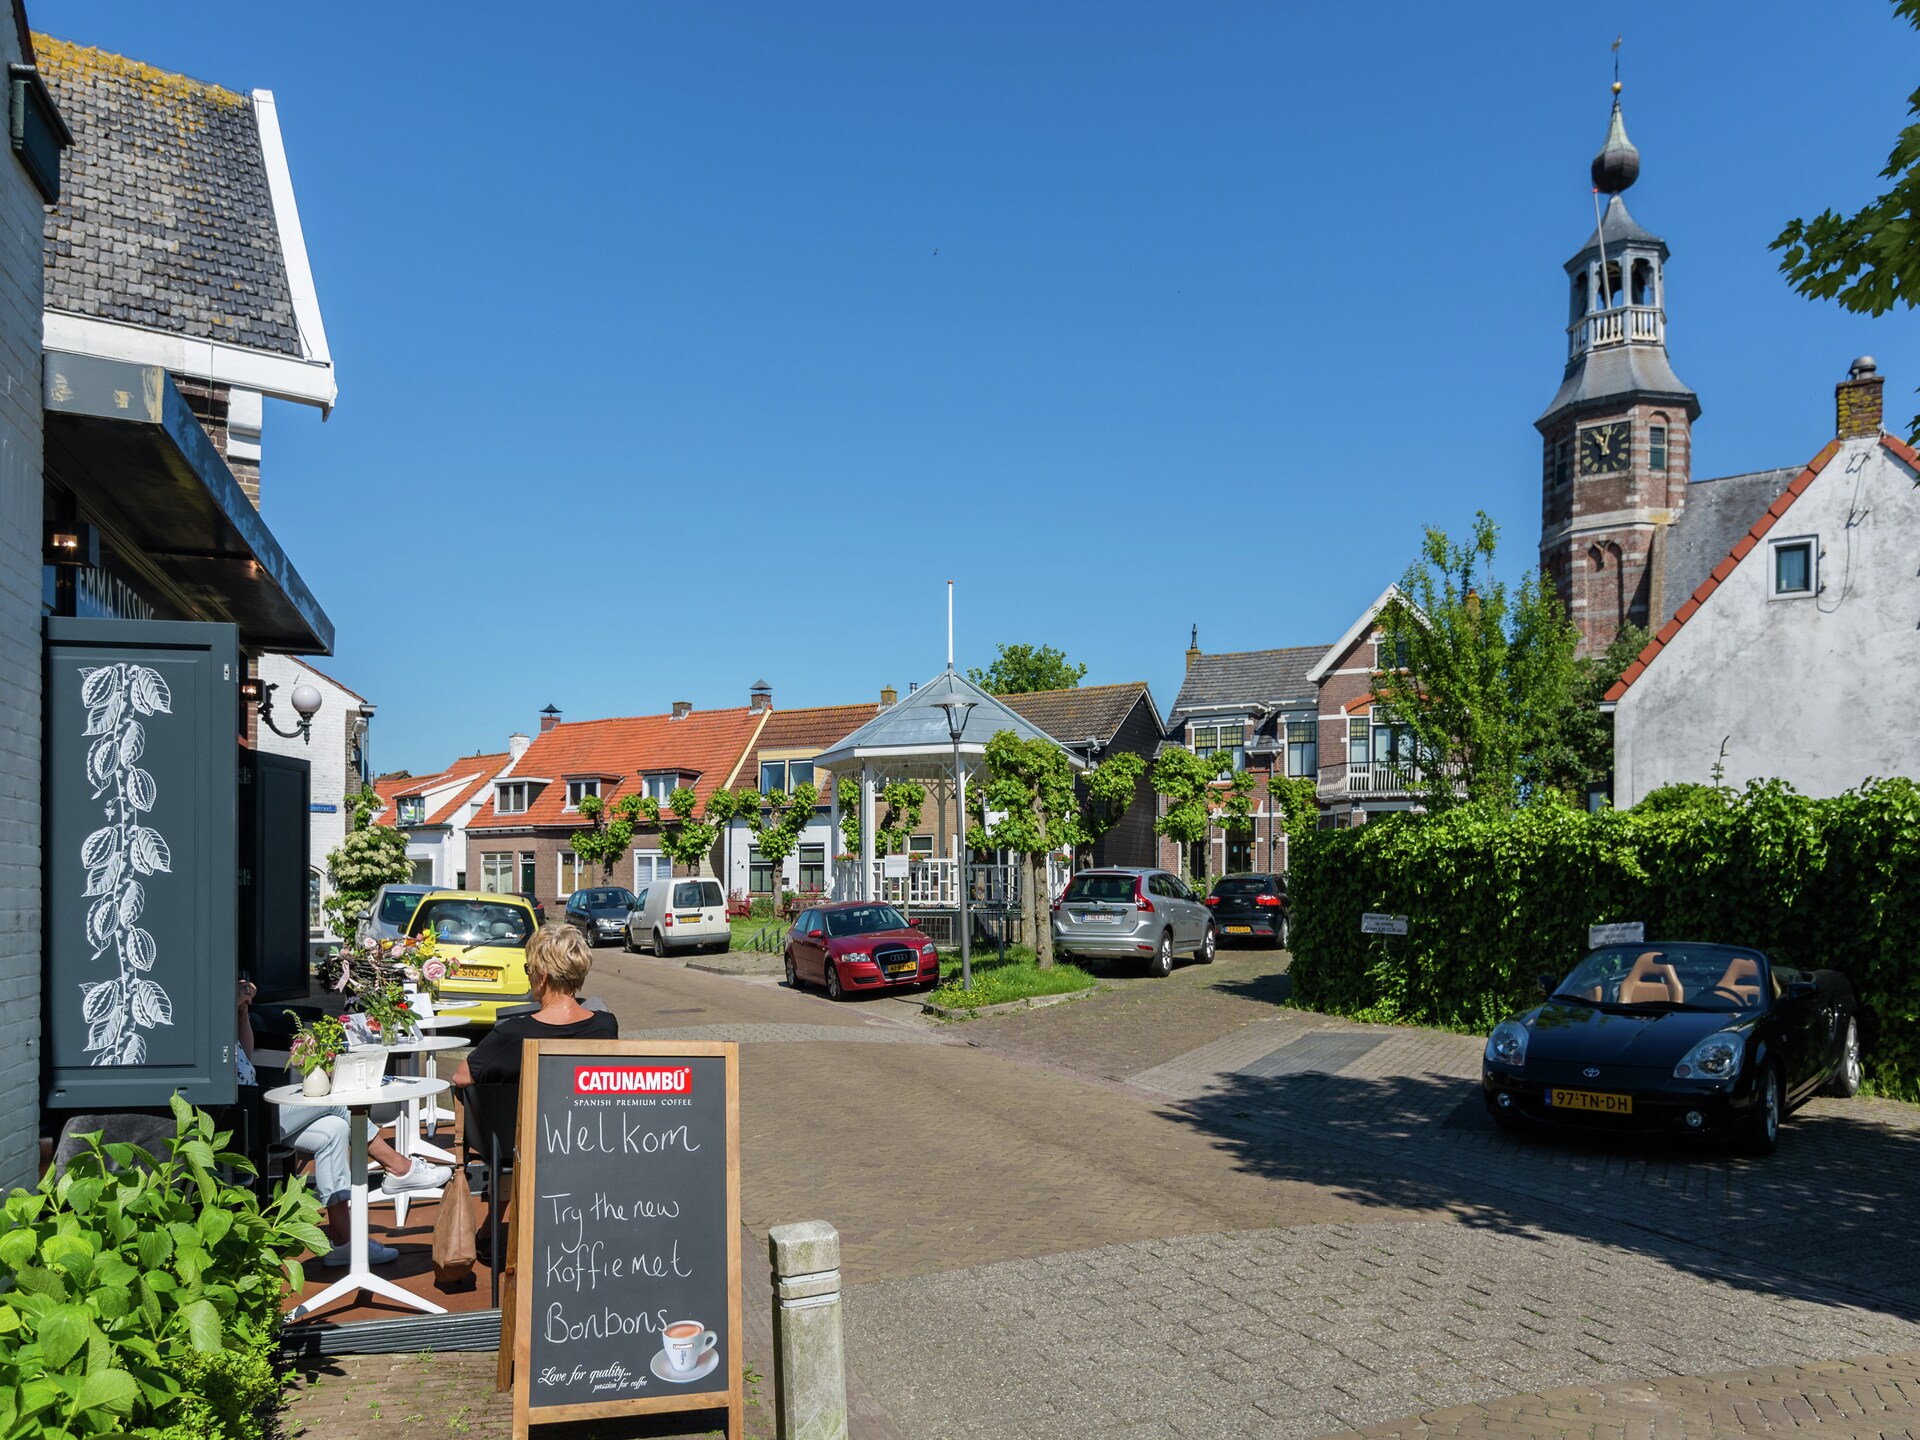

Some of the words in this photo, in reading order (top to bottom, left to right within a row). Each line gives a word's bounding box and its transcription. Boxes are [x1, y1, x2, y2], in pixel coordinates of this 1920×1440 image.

[79, 568, 113, 618] EMMA
[454, 968, 495, 977] -SNZ-29
[577, 1070, 687, 1091] CATUNAMBÚ
[1556, 1091, 1628, 1111] 97-TN-DH
[542, 1193, 583, 1253] Try
[590, 1192, 628, 1221] the
[633, 1199, 680, 1219] new
[544, 1301, 668, 1344] Bonbons
[538, 1366, 567, 1386] Love
[566, 1364, 587, 1386] for
[589, 1361, 632, 1382] quality...
[592, 1382, 617, 1393] passion
[616, 1378, 629, 1391] for
[630, 1376, 647, 1389] coffee
